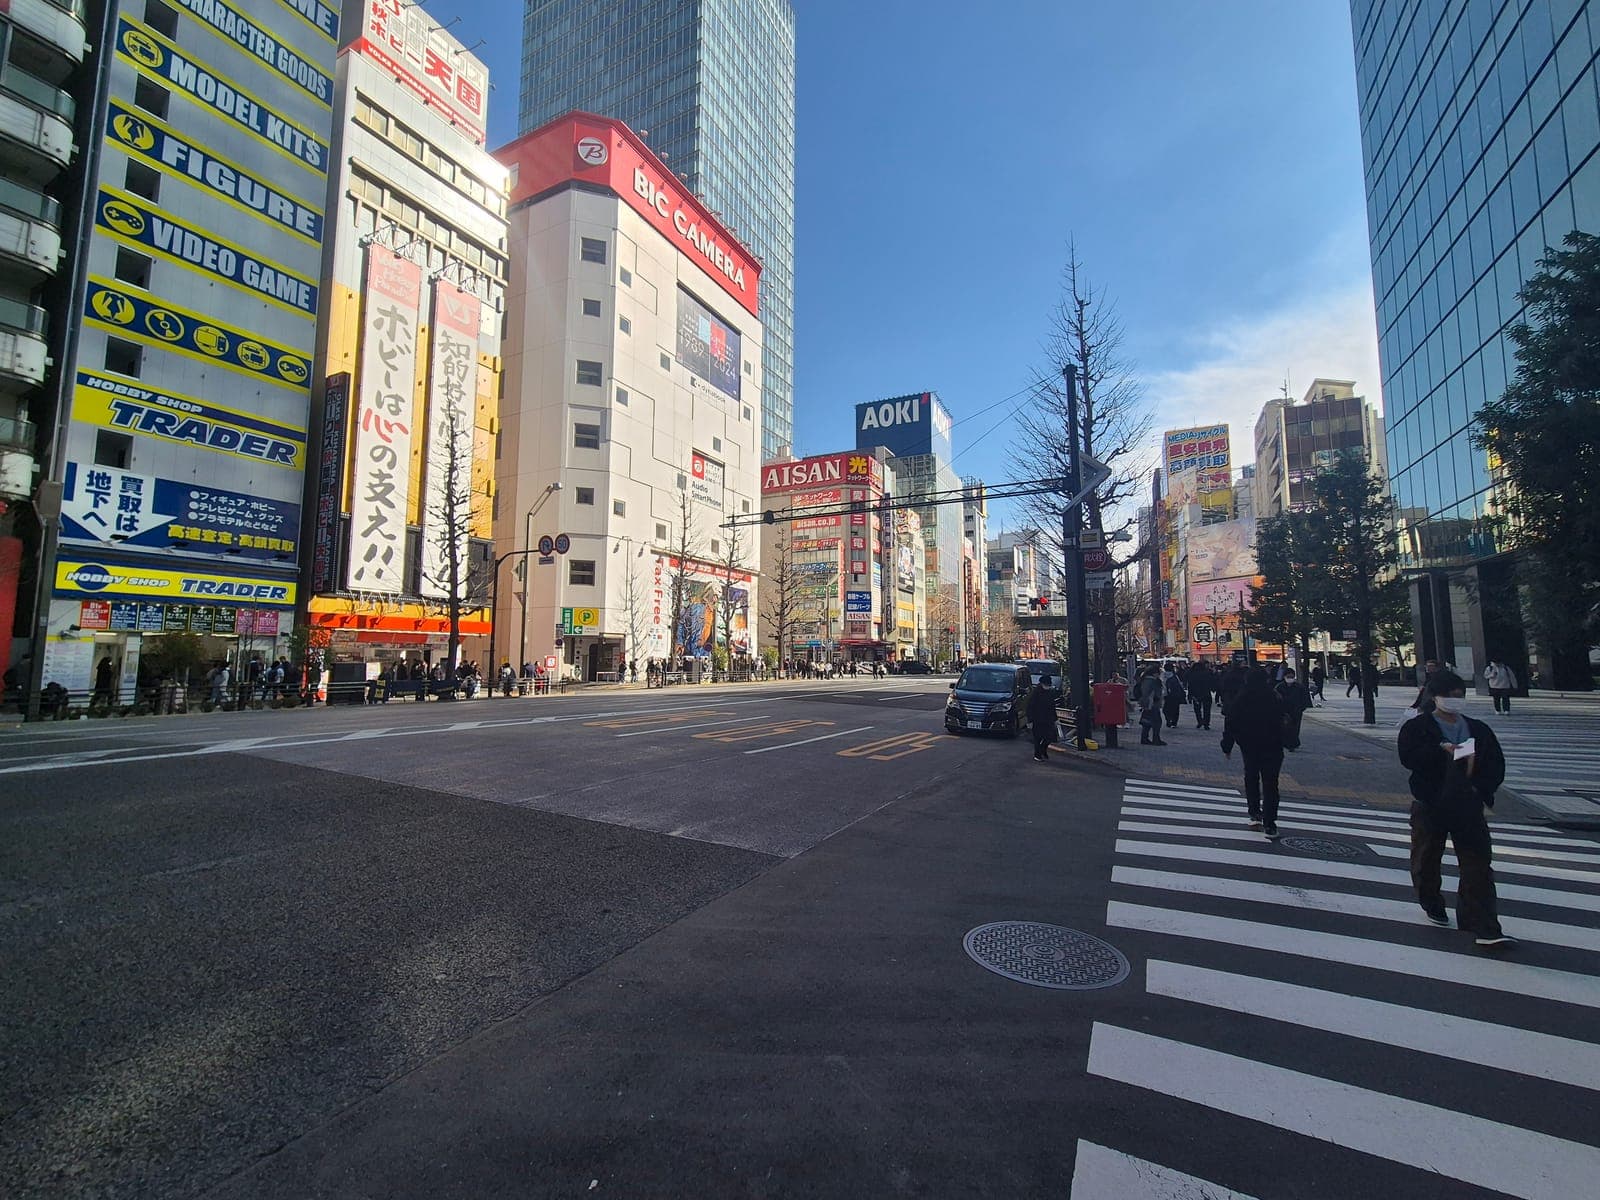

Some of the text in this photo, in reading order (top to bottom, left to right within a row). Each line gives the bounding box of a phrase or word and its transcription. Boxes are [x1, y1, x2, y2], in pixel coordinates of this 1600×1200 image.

[180, 0, 327, 100] HARACTER GOODS
[169, 54, 322, 167] MODEL KITS
[161, 135, 316, 237] FIGURE
[633, 167, 747, 293] BIC CAMERA
[152, 216, 310, 310] VIDEO GAME
[87, 377, 203, 415] HOBBY SHOP
[861, 399, 920, 430] AOKI
[109, 398, 299, 467] TRADER
[764, 459, 842, 489] AISAN
[848, 456, 868, 475] 光
[82, 470, 112, 528] 地下へ
[118, 475, 145, 532] 買取は
[198, 512, 278, 532] プラモデルなどなど
[199, 502, 284, 523] テレビゲーム・グッズ
[66, 571, 170, 588] HOBBY SHOP
[180, 578, 289, 600] TRADER
[653, 555, 665, 625] Tax Free
[847, 612, 870, 620] AISAN
